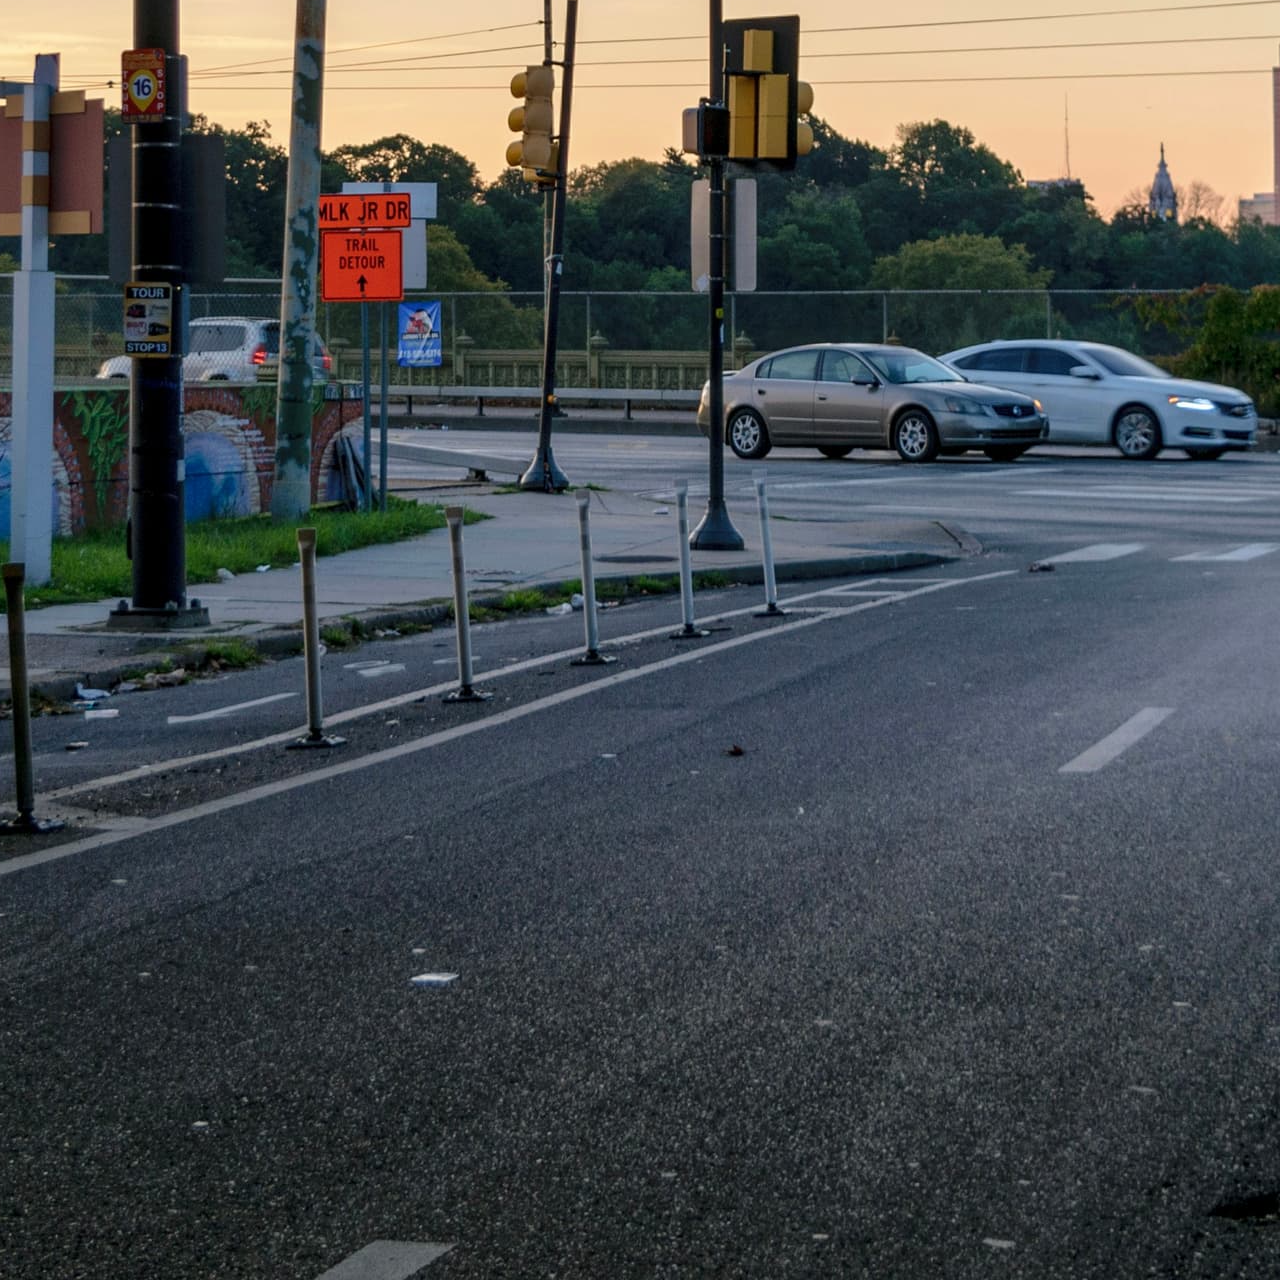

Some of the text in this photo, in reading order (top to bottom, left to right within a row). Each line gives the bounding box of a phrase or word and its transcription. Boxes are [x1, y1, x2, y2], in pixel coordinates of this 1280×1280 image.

[133, 78, 152, 97] 16
[156, 69, 164, 111] STOP
[319, 201, 408, 221] MLK JR DR
[345, 238, 379, 252] TRAIL
[339, 255, 385, 270] DETOUR
[131, 287, 164, 298] TOUR
[127, 342, 167, 353] STOP 13
